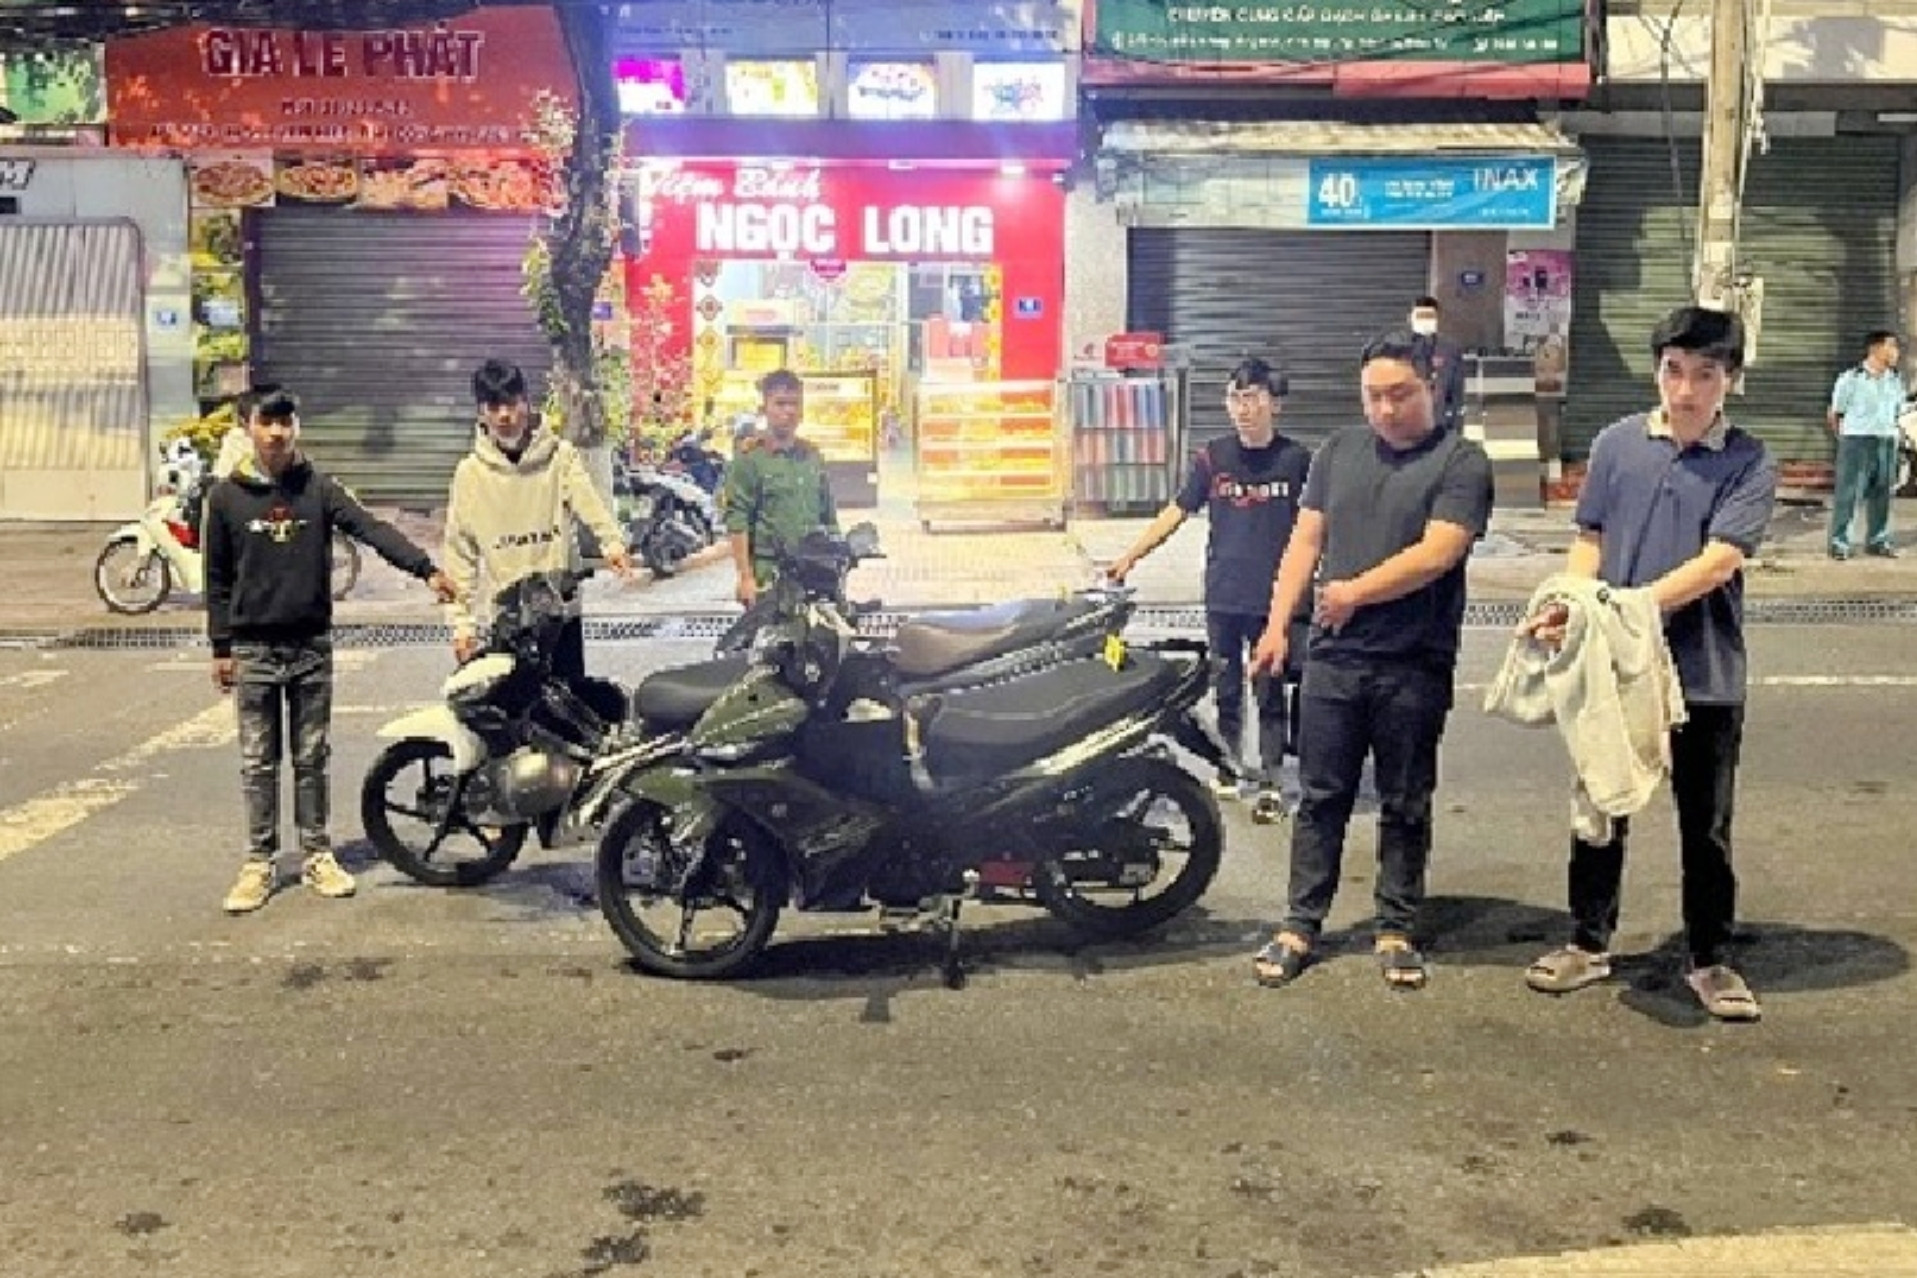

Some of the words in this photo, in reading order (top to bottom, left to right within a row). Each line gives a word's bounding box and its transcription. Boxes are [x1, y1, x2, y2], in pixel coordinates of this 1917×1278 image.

[203, 27, 283, 76] GIA
[1318, 173, 1356, 208] 40
[1475, 167, 1539, 191] INAX
[696, 203, 835, 261] NGỌC
[864, 205, 994, 253] LONG
